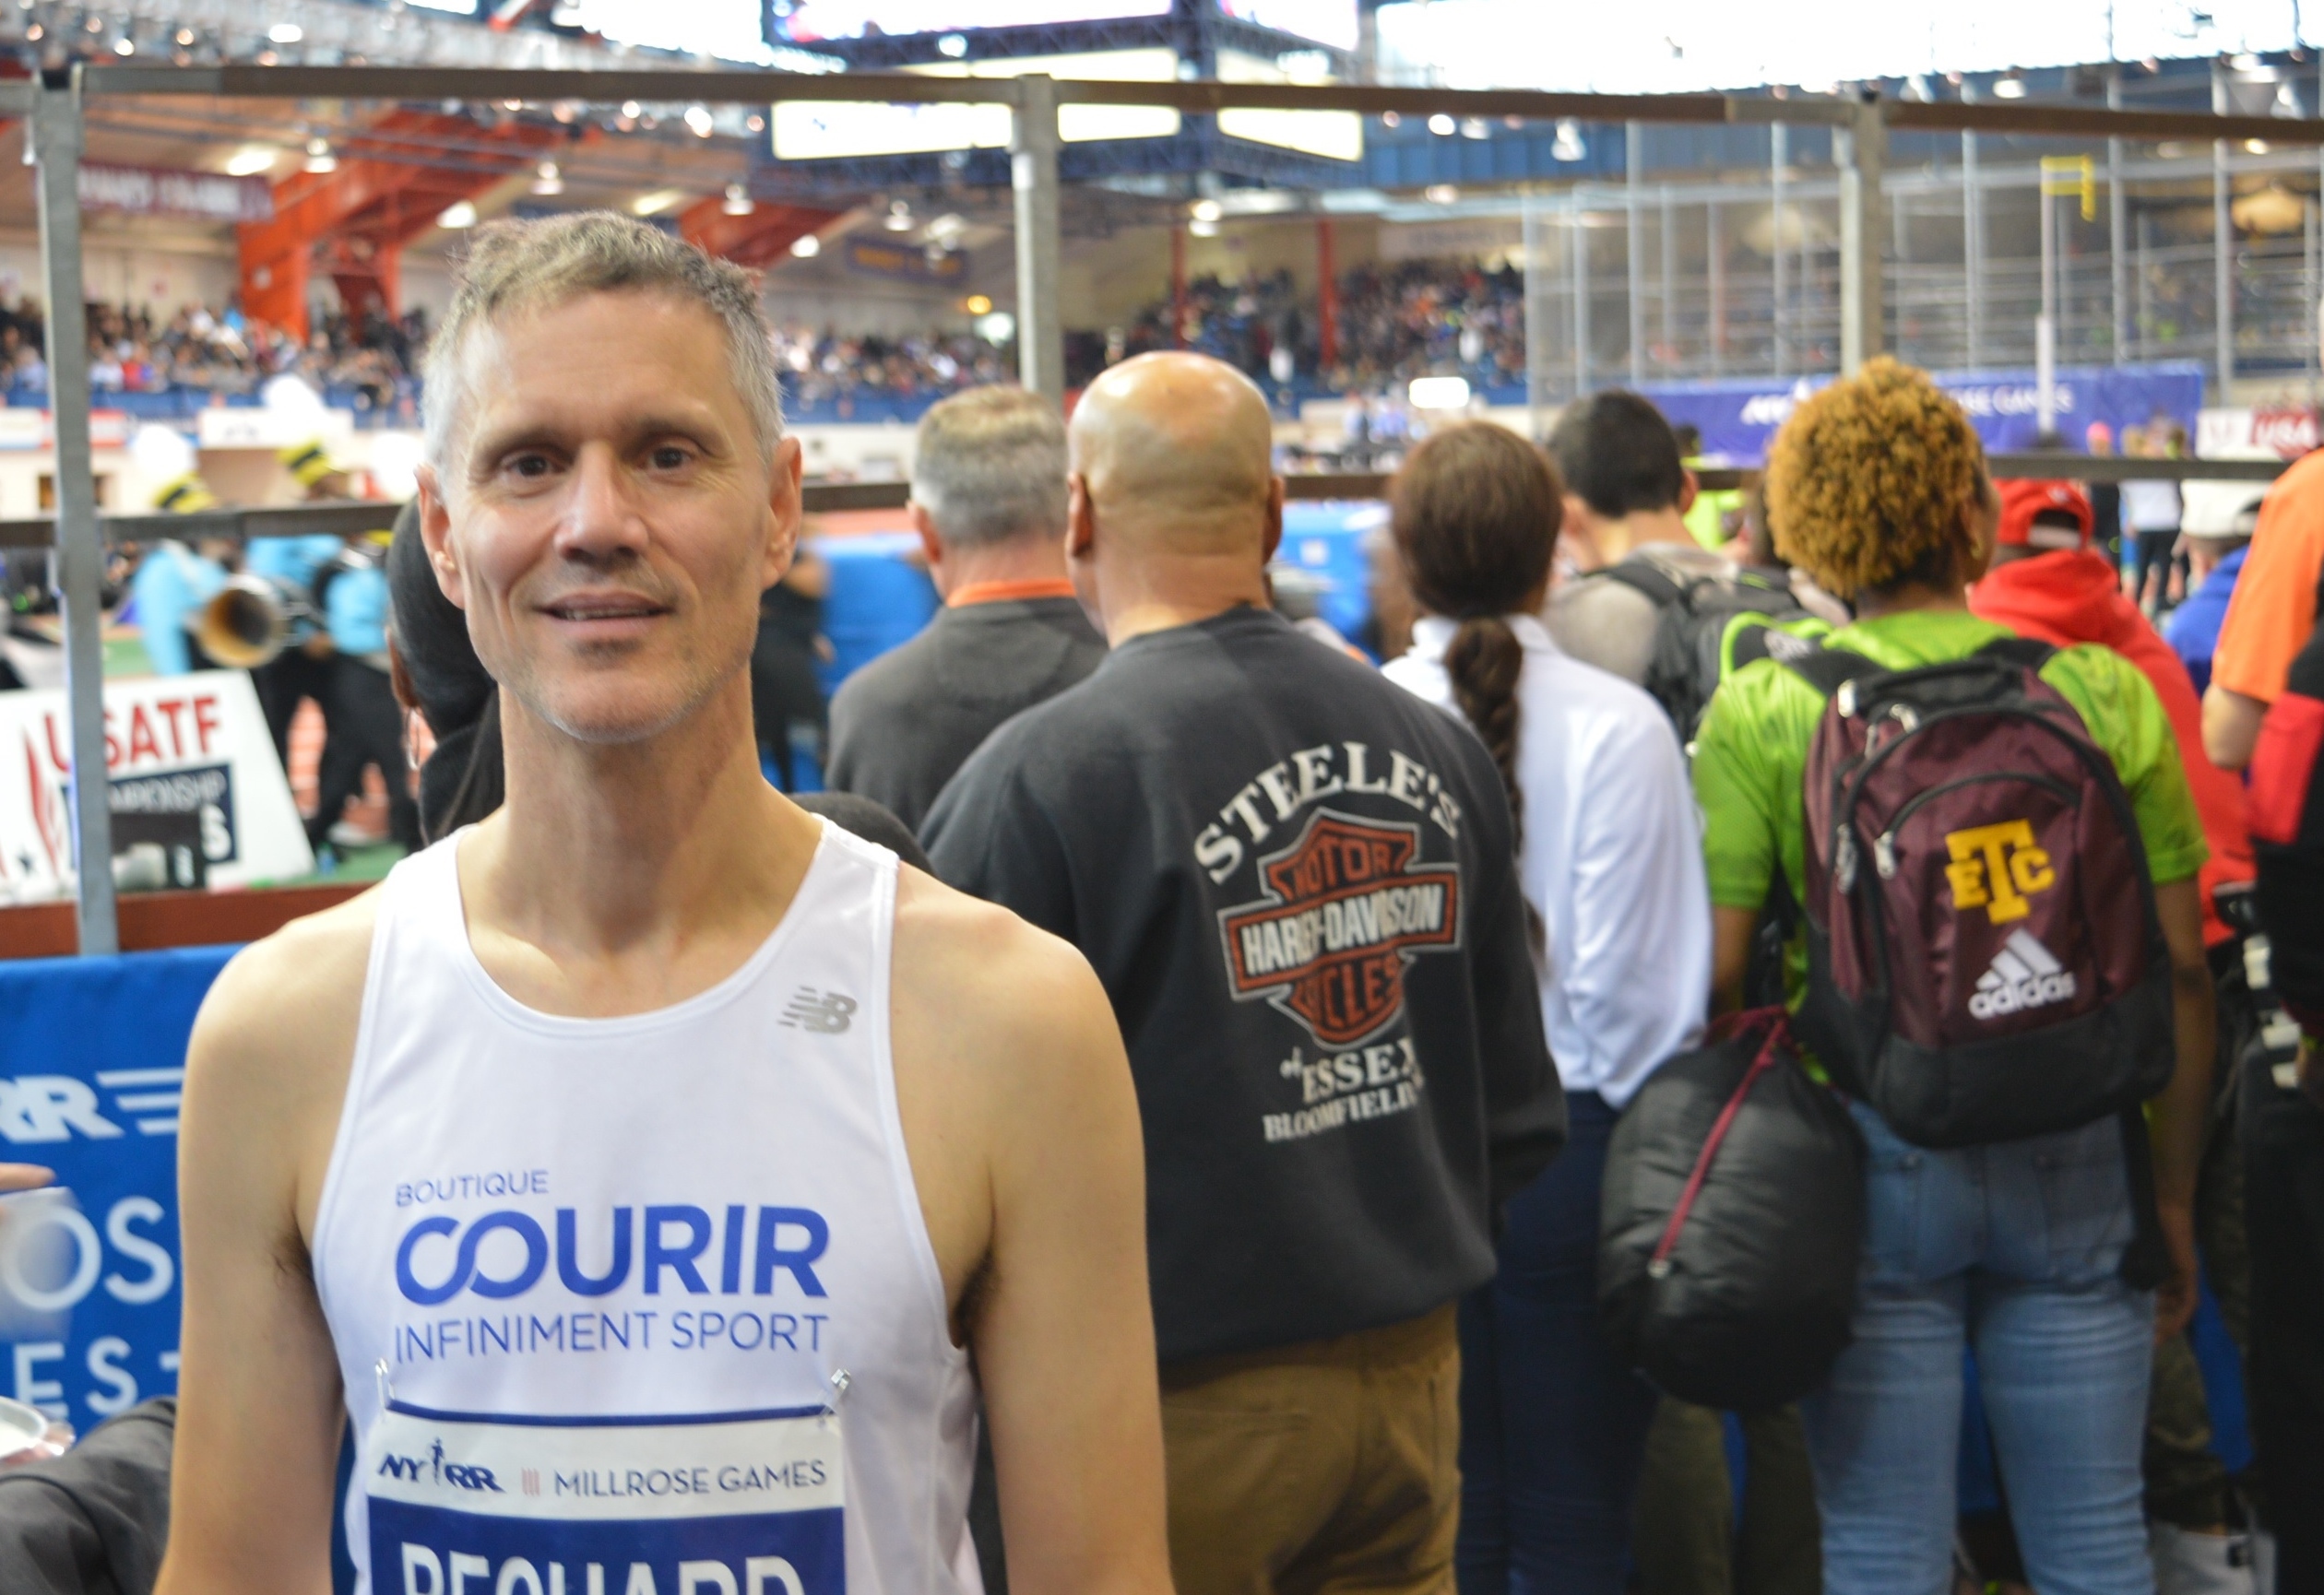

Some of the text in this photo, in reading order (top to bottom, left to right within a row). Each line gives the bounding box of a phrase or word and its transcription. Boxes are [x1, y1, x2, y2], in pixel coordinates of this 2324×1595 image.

[1993, 384, 2074, 416] GAMS
[42, 694, 219, 774] USATF
[1194, 740, 1462, 885] STEELE'S
[1240, 883, 1443, 977] HAREY-DAVISON
[1968, 971, 2076, 1020] adidas
[396, 1169, 549, 1207] BOUTIQUE
[395, 1204, 830, 1307] COURIR
[395, 1311, 829, 1365] INFINIMENT SPORT
[553, 1465, 709, 1498] MILLROSE
[717, 1459, 827, 1493] GAMES
